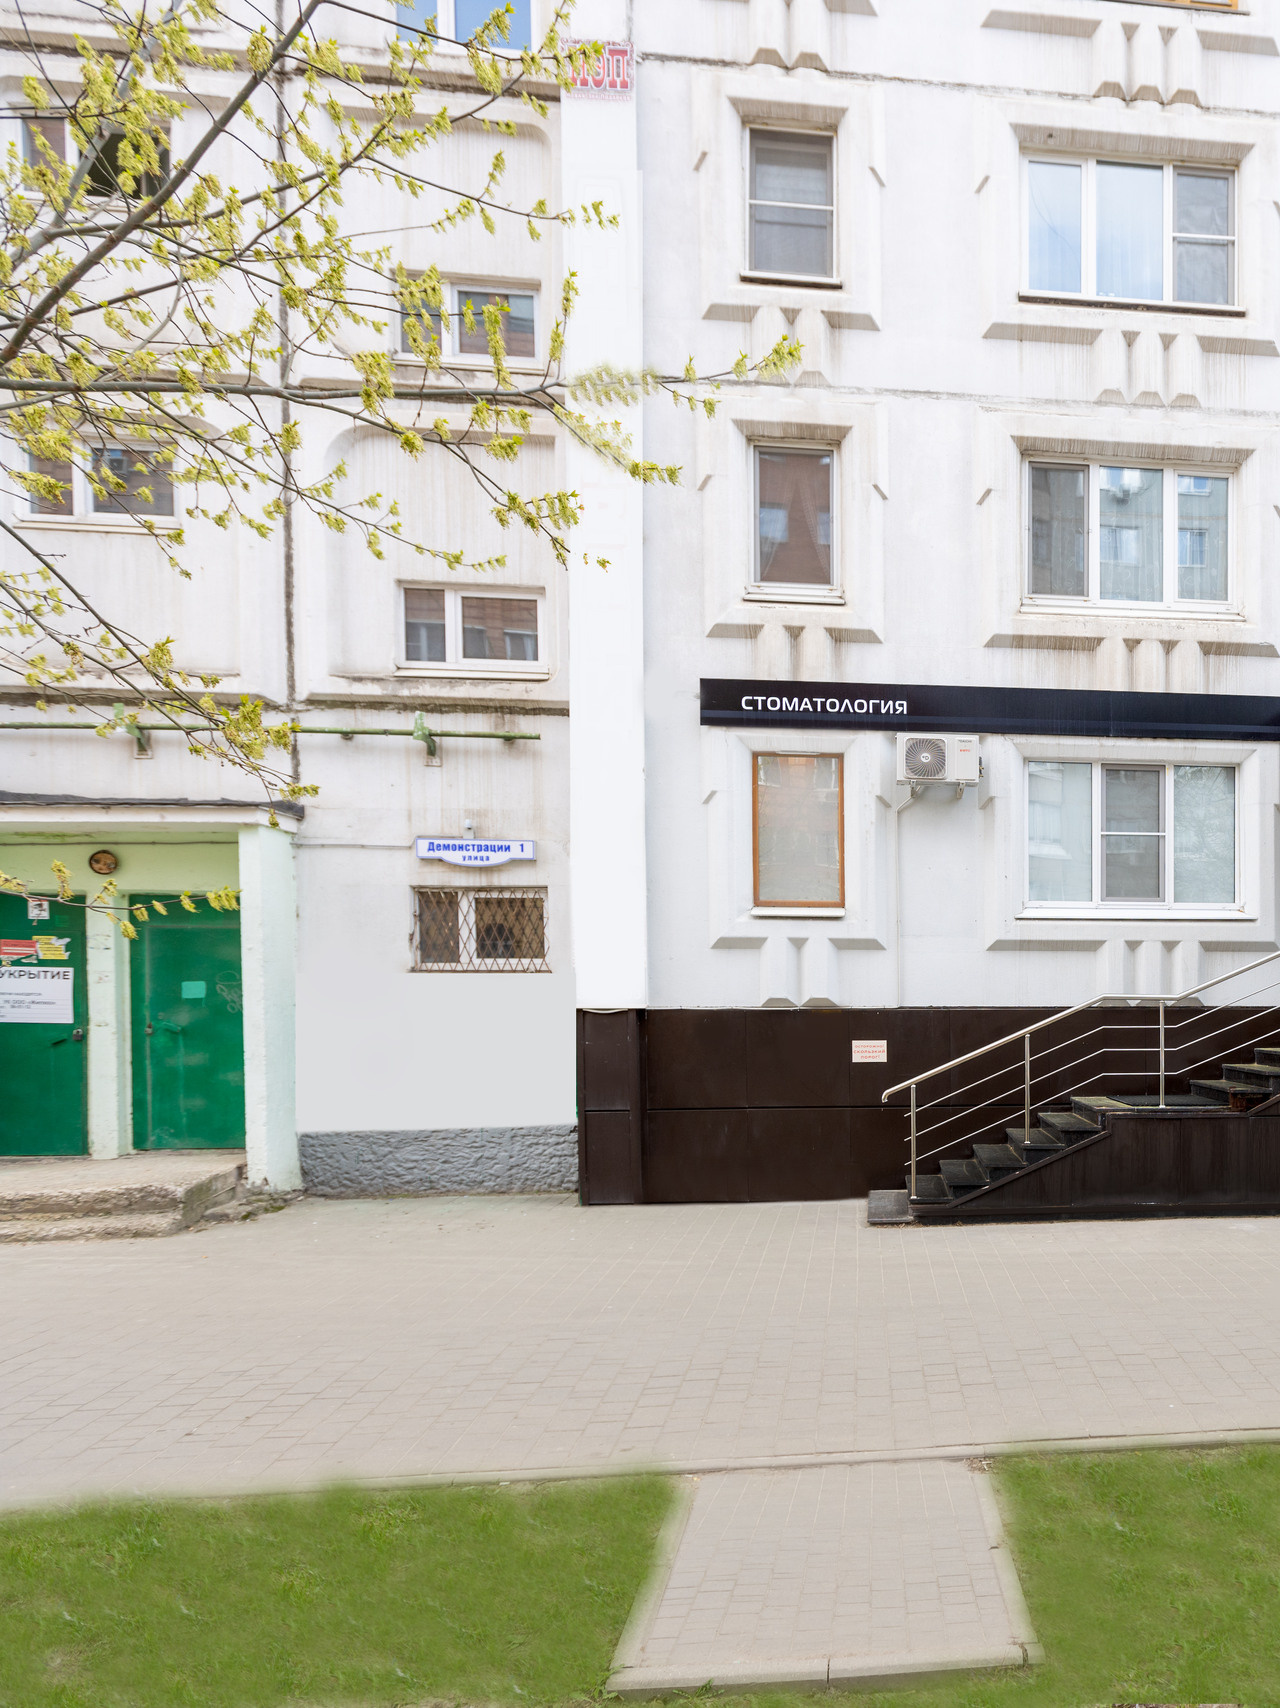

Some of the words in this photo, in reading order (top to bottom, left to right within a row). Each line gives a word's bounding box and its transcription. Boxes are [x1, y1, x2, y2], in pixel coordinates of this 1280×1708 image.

[741, 695, 908, 715] СТОМАТОЛОГИЯ
[427, 842, 511, 853] Демонстрации
[519, 843, 524, 852] 1
[0, 969, 71, 980] УКРЫТИЕ
